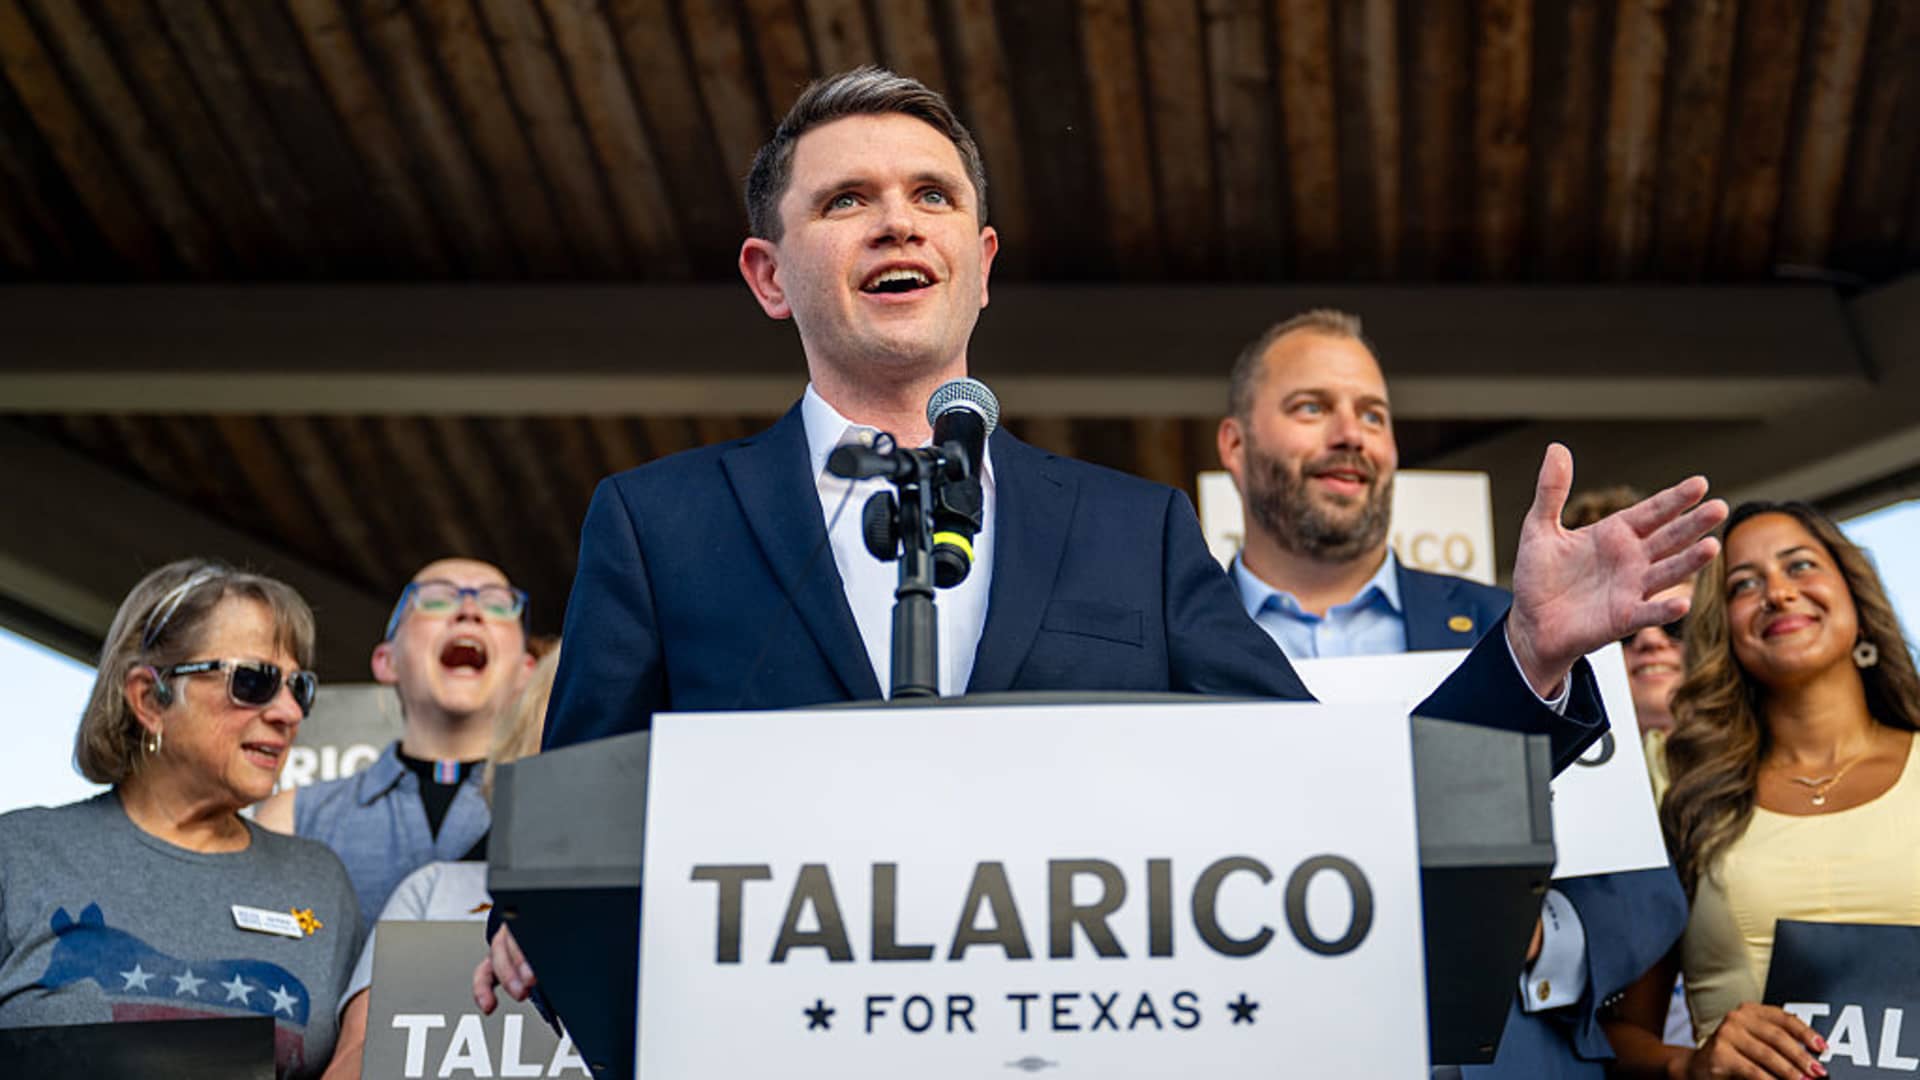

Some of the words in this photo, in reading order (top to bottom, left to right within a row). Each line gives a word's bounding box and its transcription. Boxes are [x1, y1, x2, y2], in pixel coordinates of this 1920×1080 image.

[690, 855, 1375, 965] TALARICO
[865, 994, 977, 1034] FOR
[1005, 991, 1202, 1033] TEXAS
[391, 1013, 593, 1078] TALA
